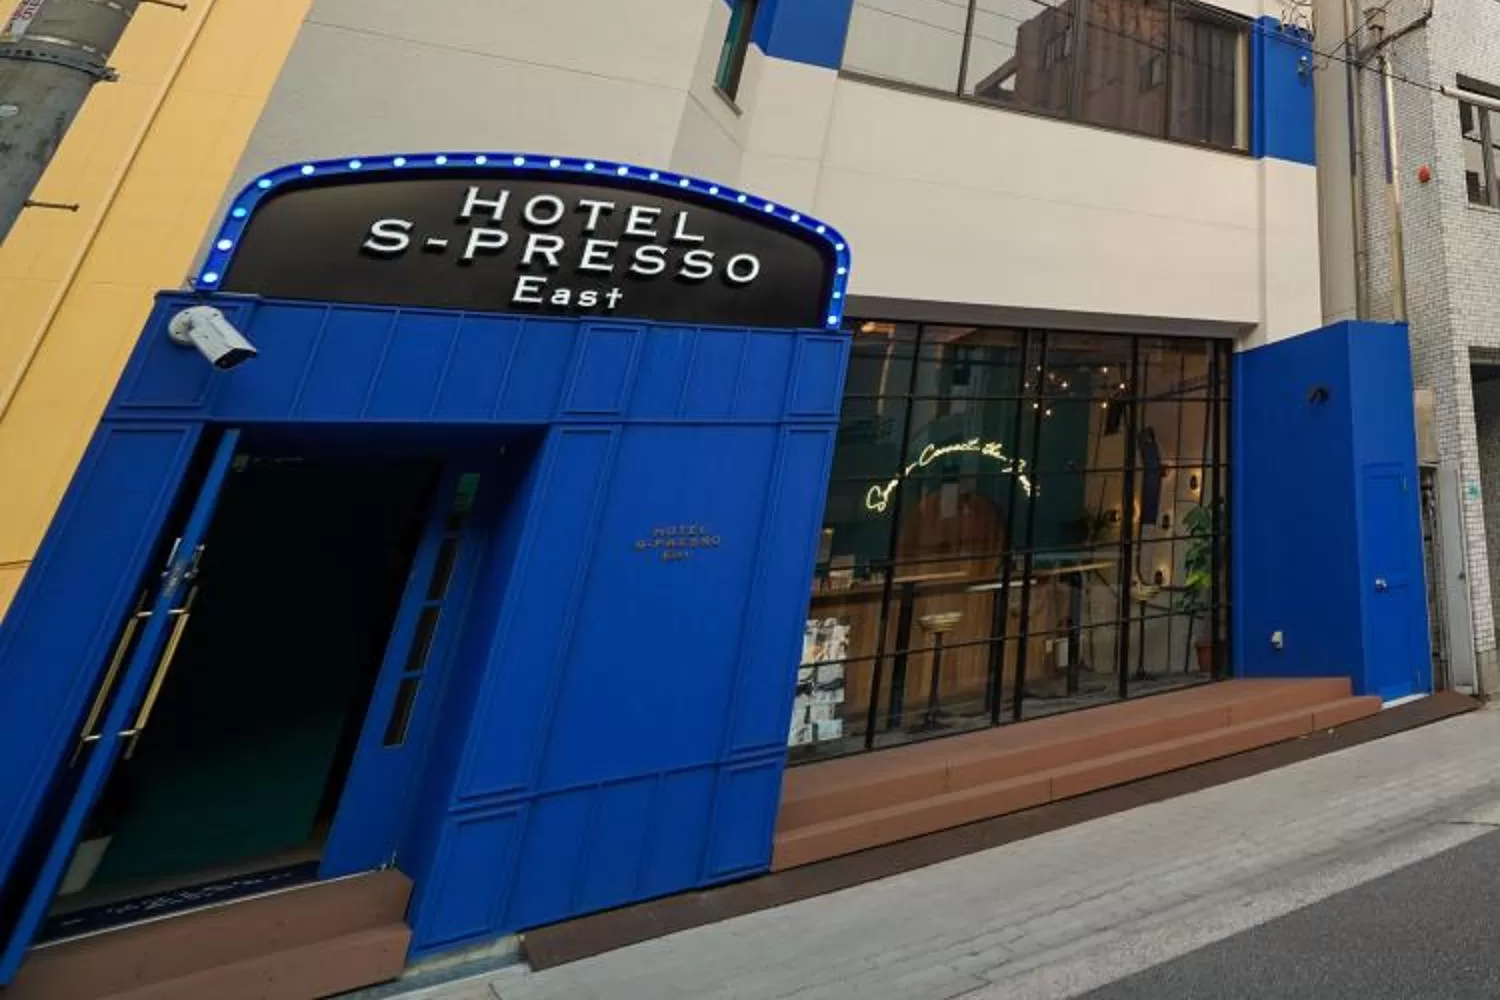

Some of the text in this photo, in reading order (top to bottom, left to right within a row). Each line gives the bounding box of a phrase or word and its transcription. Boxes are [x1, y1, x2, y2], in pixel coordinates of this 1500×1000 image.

[459, 186, 705, 242] HOTEL
[363, 218, 761, 283] S-PRESSO
[511, 275, 624, 309] East
